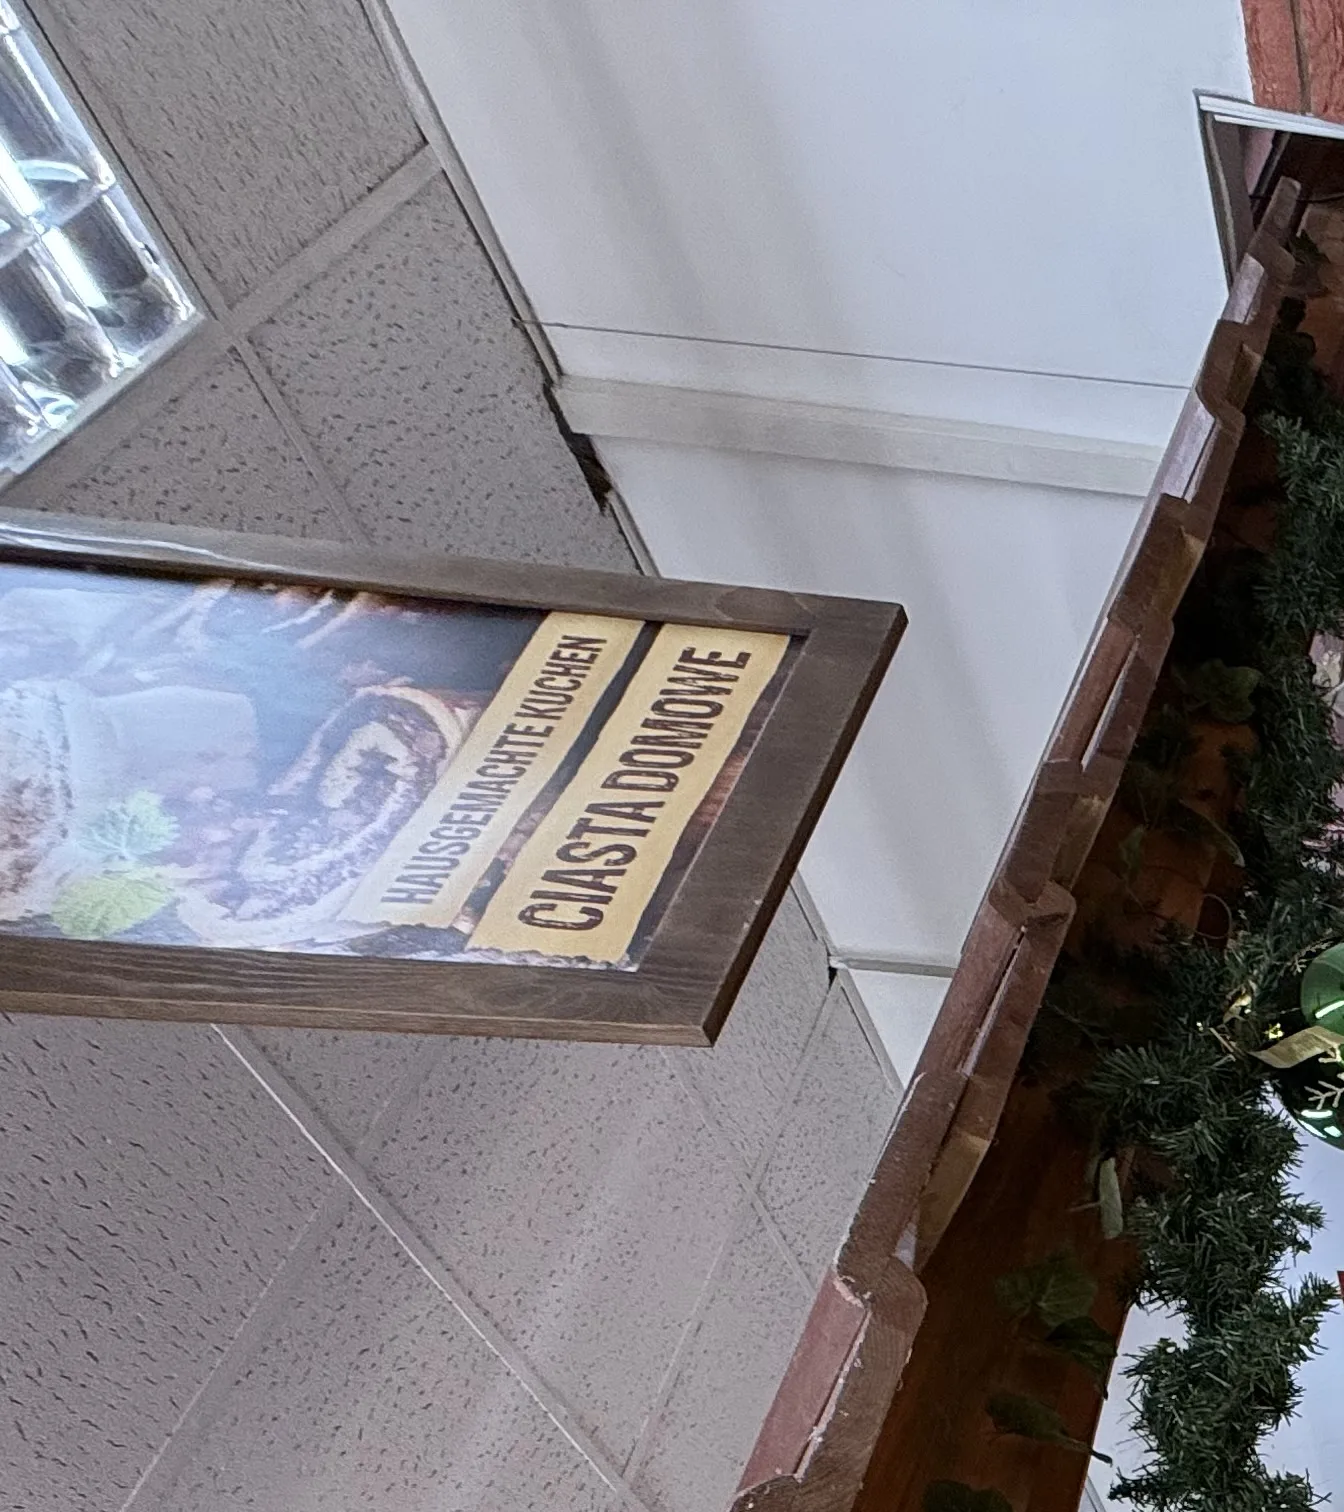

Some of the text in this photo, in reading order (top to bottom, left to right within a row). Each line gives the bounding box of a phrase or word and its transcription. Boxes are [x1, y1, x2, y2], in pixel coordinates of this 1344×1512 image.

[381, 635, 608, 905] HAUSGEMACHTE KUCHEN
[517, 646, 752, 931] CIASTA DOMOWE
